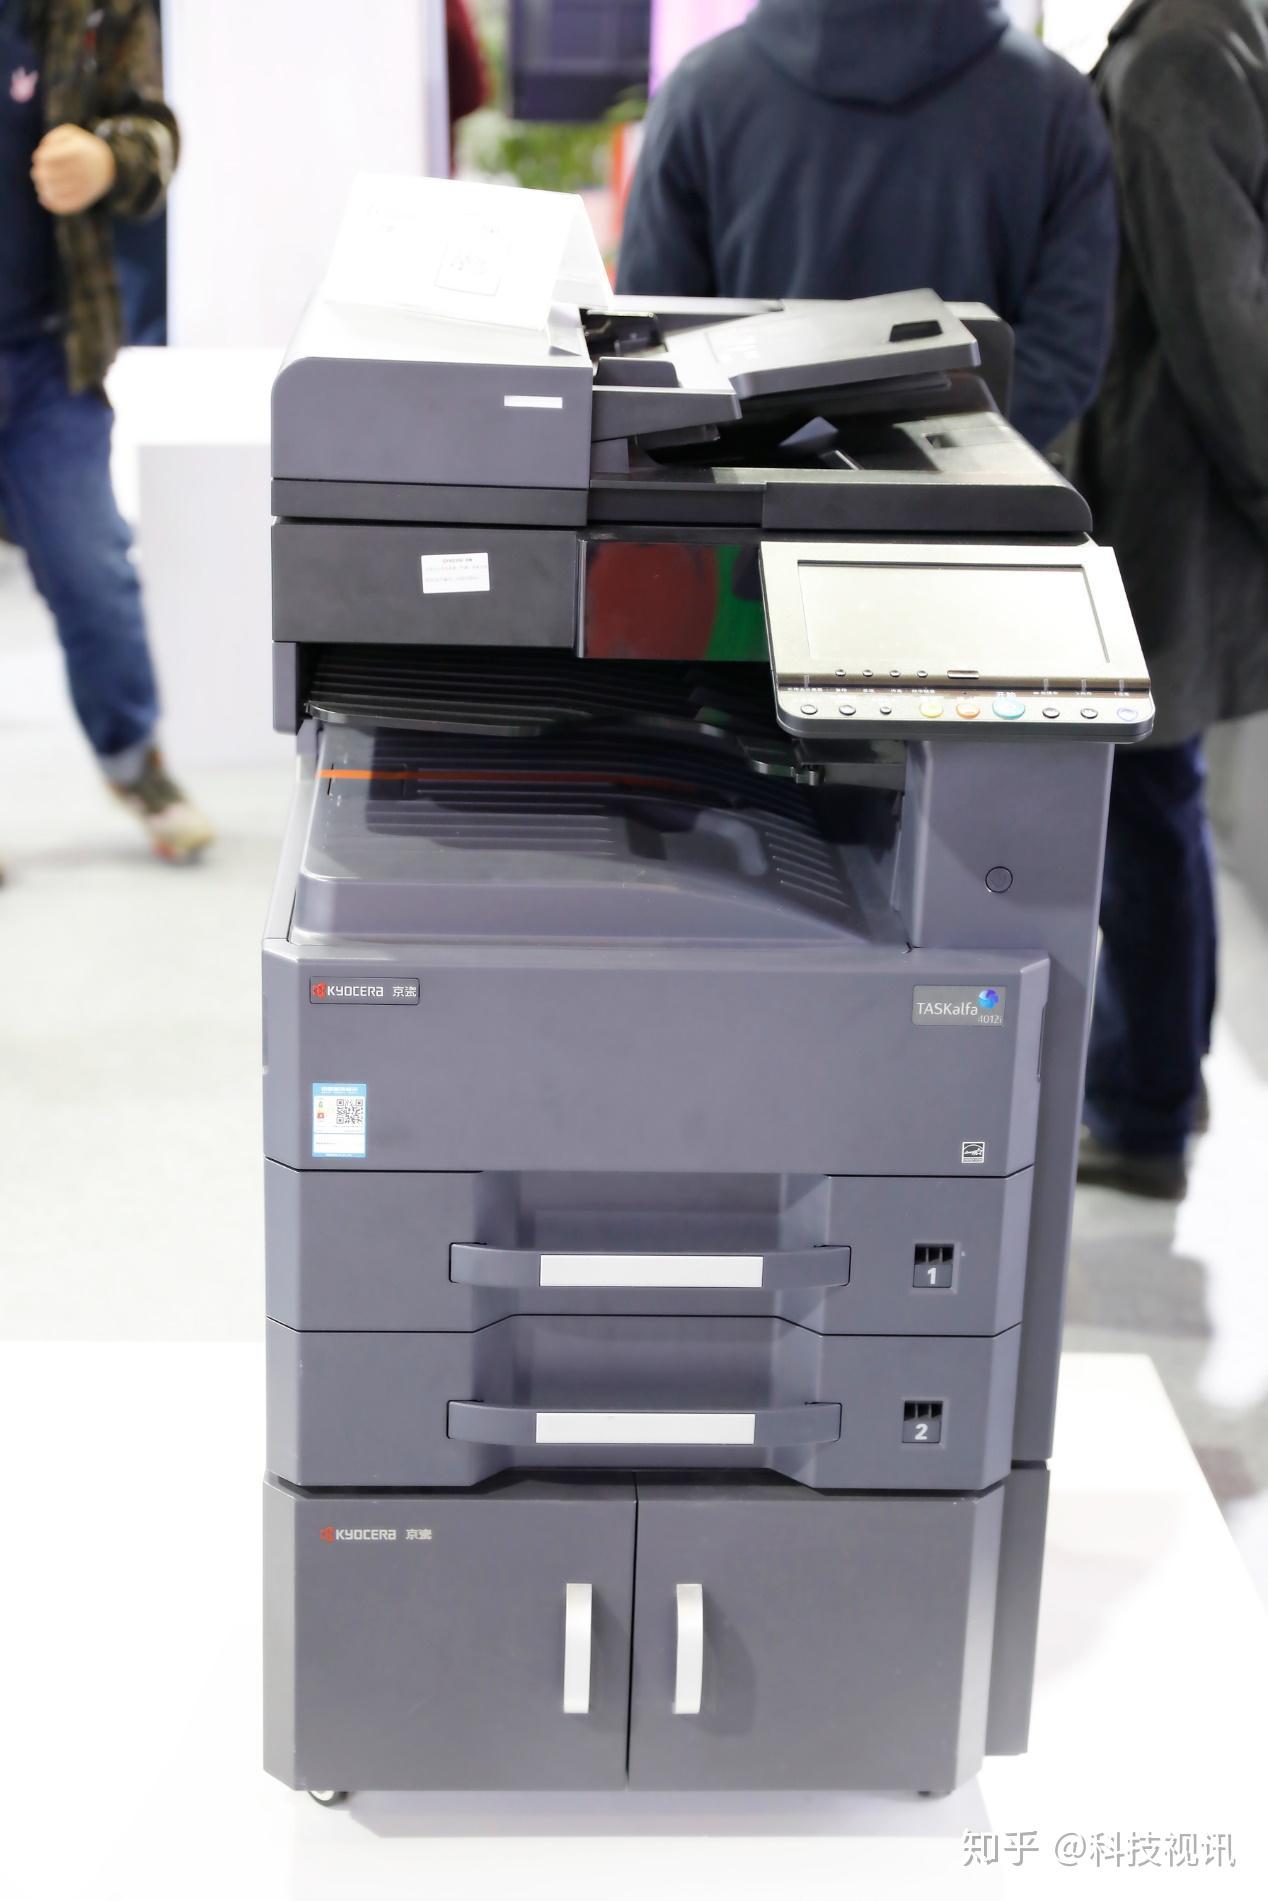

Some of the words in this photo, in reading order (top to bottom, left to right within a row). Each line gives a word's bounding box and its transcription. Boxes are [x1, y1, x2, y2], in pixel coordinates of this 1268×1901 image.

[327, 985, 384, 997] KYOCERA
[392, 985, 417, 998] 京瓷
[916, 1002, 979, 1016] TASKalfa
[977, 1014, 1003, 1024] 4012i
[927, 1267, 937, 1285] 1
[914, 1423, 929, 1441] 2
